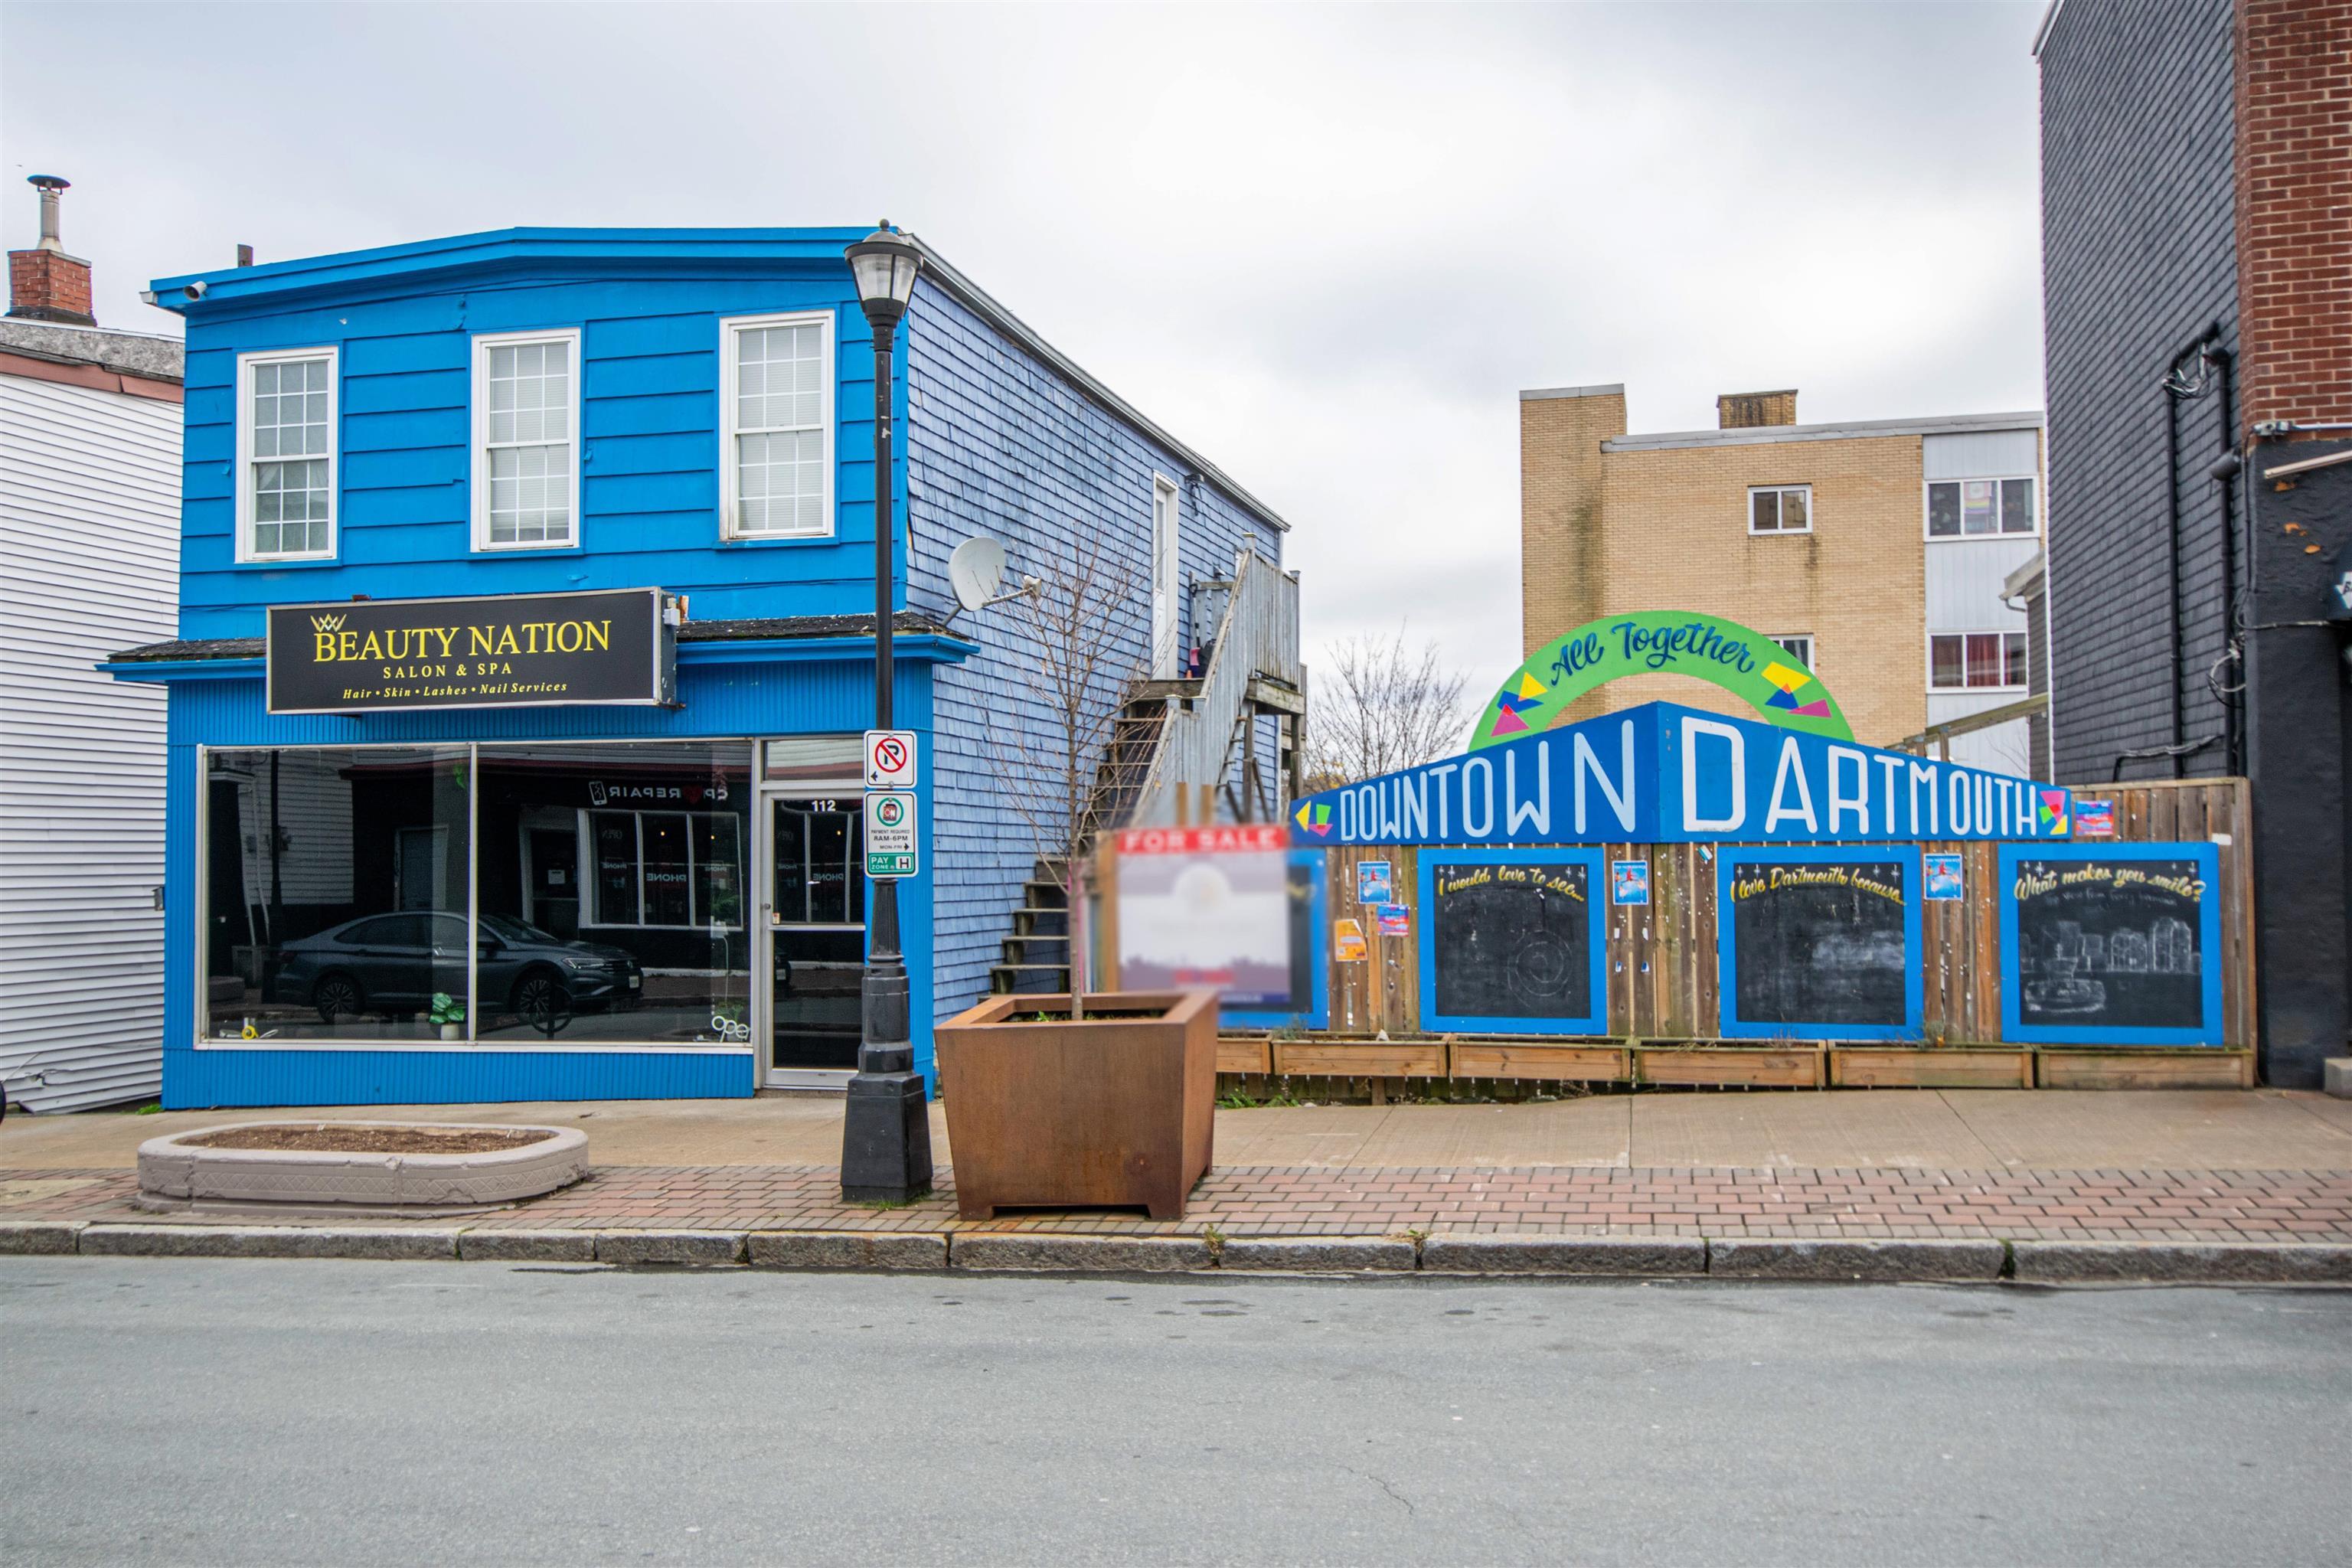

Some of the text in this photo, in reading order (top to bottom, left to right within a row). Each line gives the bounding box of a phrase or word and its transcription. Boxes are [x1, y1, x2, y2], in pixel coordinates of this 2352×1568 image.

[313, 620, 612, 662] BEAUTY NATION
[1550, 621, 1755, 686] All Together
[383, 662, 512, 678] SALON & SPA
[343, 682, 567, 699] Hair Skin Lashes Nail Services
[1339, 719, 1637, 841] DOWNTOWN
[1681, 716, 2037, 835] DARTMOUTH
[812, 799, 837, 812] 112
[1125, 829, 1278, 850] FOR SALE
[900, 858, 910, 869] H
[1439, 878, 1444, 896] I
[1447, 867, 1491, 892] would
[1498, 865, 1526, 881] love
[1529, 867, 1547, 884] to
[1730, 880, 1736, 903] I
[1738, 878, 1766, 899] love
[1769, 866, 1848, 890] Dartmouth
[2014, 871, 2057, 900] What
[2062, 863, 2112, 885] makes
[2115, 867, 2145, 887] you
